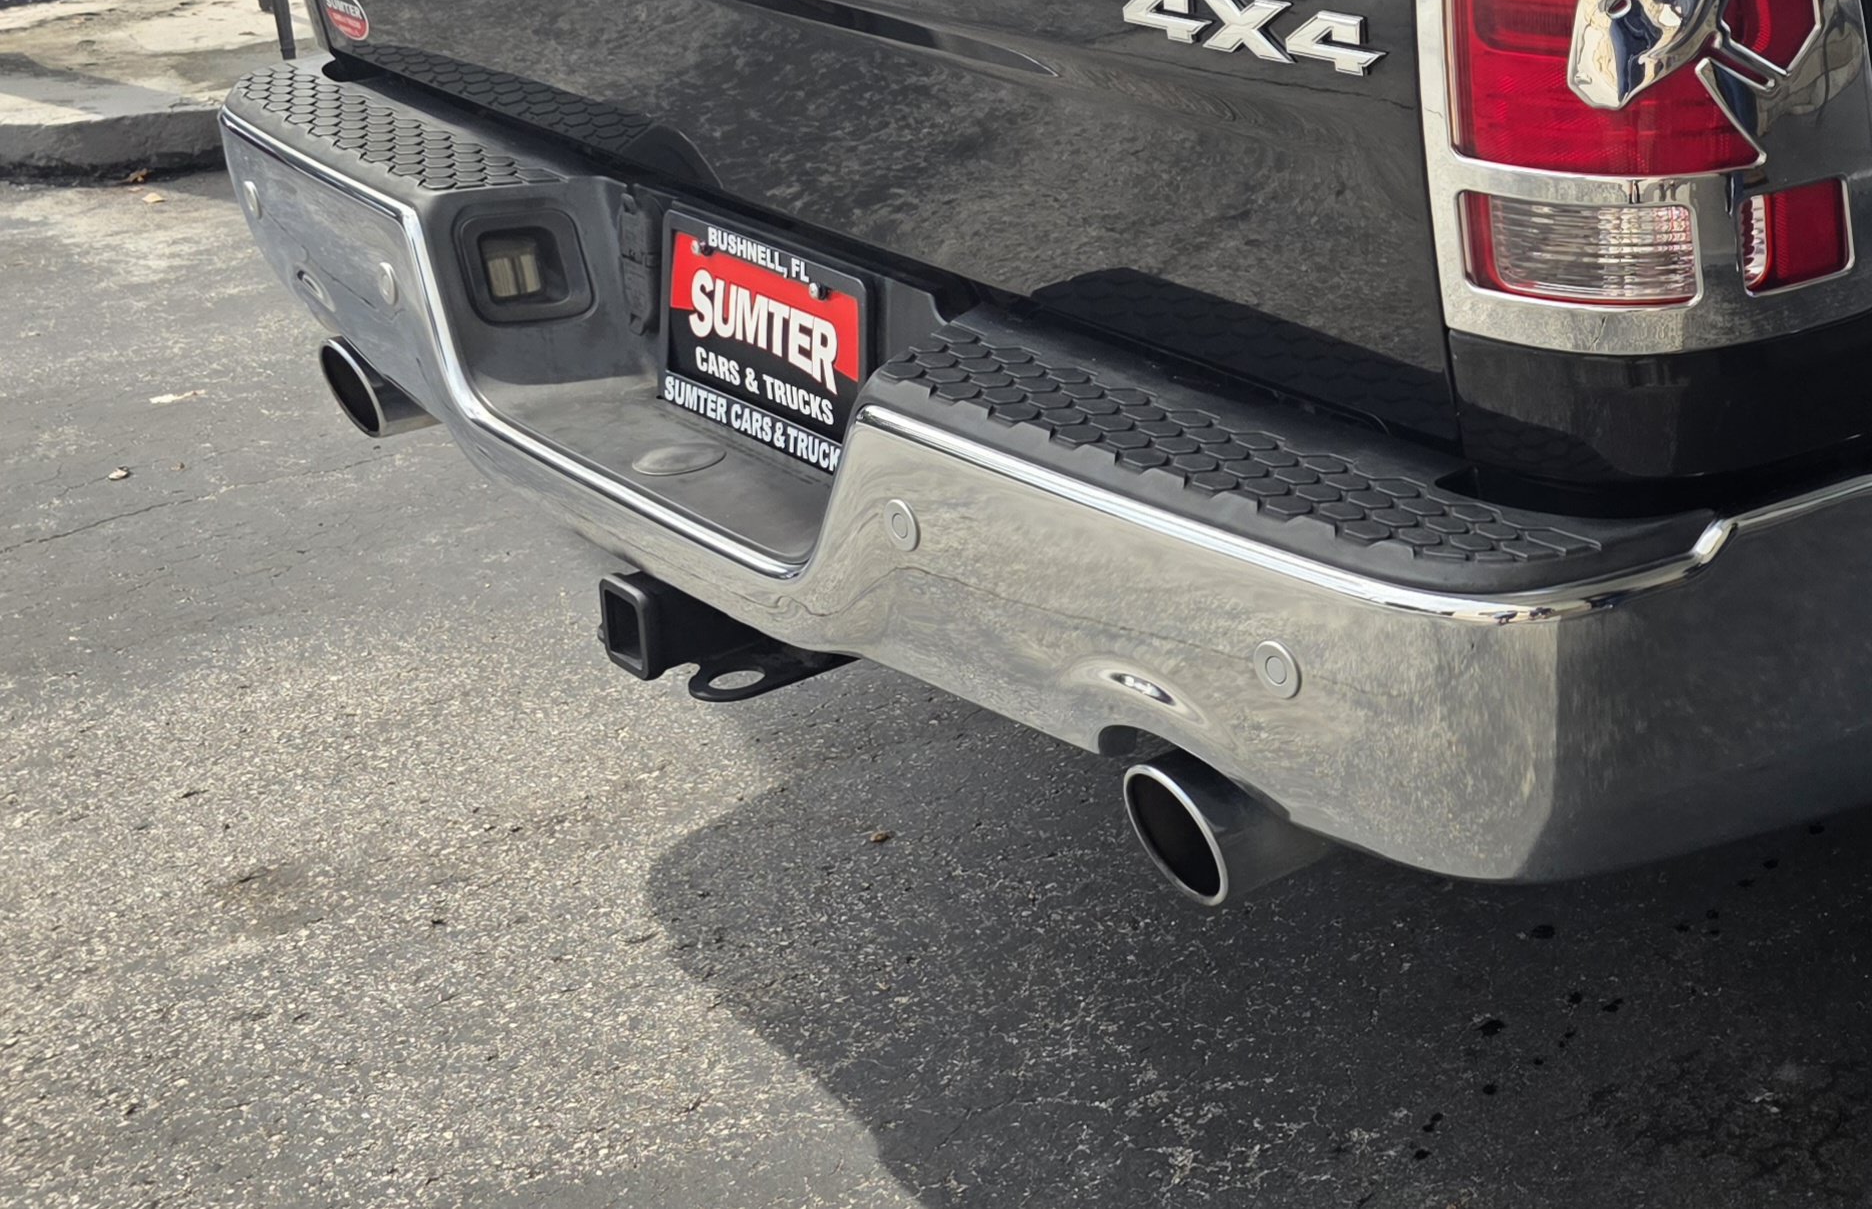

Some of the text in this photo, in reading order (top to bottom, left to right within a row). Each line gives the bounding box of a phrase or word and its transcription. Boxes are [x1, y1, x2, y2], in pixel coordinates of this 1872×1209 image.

[708, 227, 810, 283] BUSHNELL, FL
[689, 269, 838, 395] SUMTER
[664, 376, 842, 472] SUMTER CARS & TRUCK
[695, 346, 834, 425] CARS & TRUCKS
